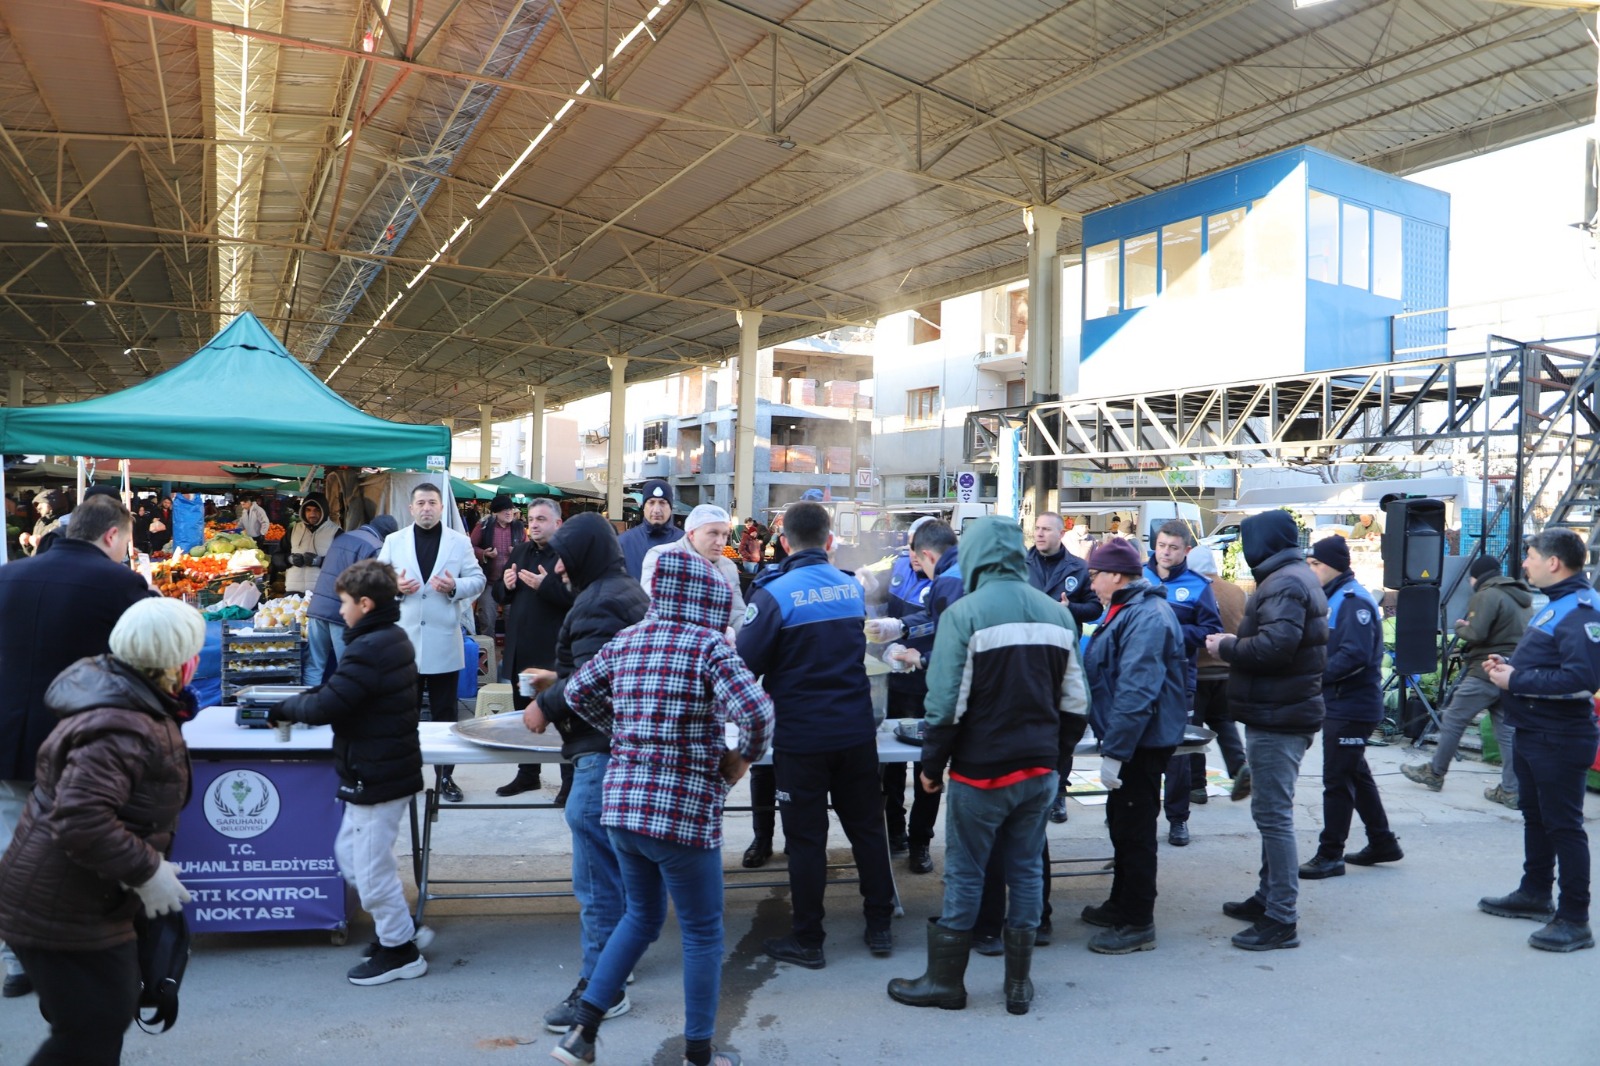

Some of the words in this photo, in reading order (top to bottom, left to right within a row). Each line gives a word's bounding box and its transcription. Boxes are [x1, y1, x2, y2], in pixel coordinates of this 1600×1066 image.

[790, 584, 860, 607] ZABITA
[228, 843, 256, 855] T.C.
[243, 856, 335, 872] BELEDİYESİ
[187, 889, 221, 902] RTI
[226, 886, 328, 902] KONTROL
[195, 906, 295, 921] NOKTASI
